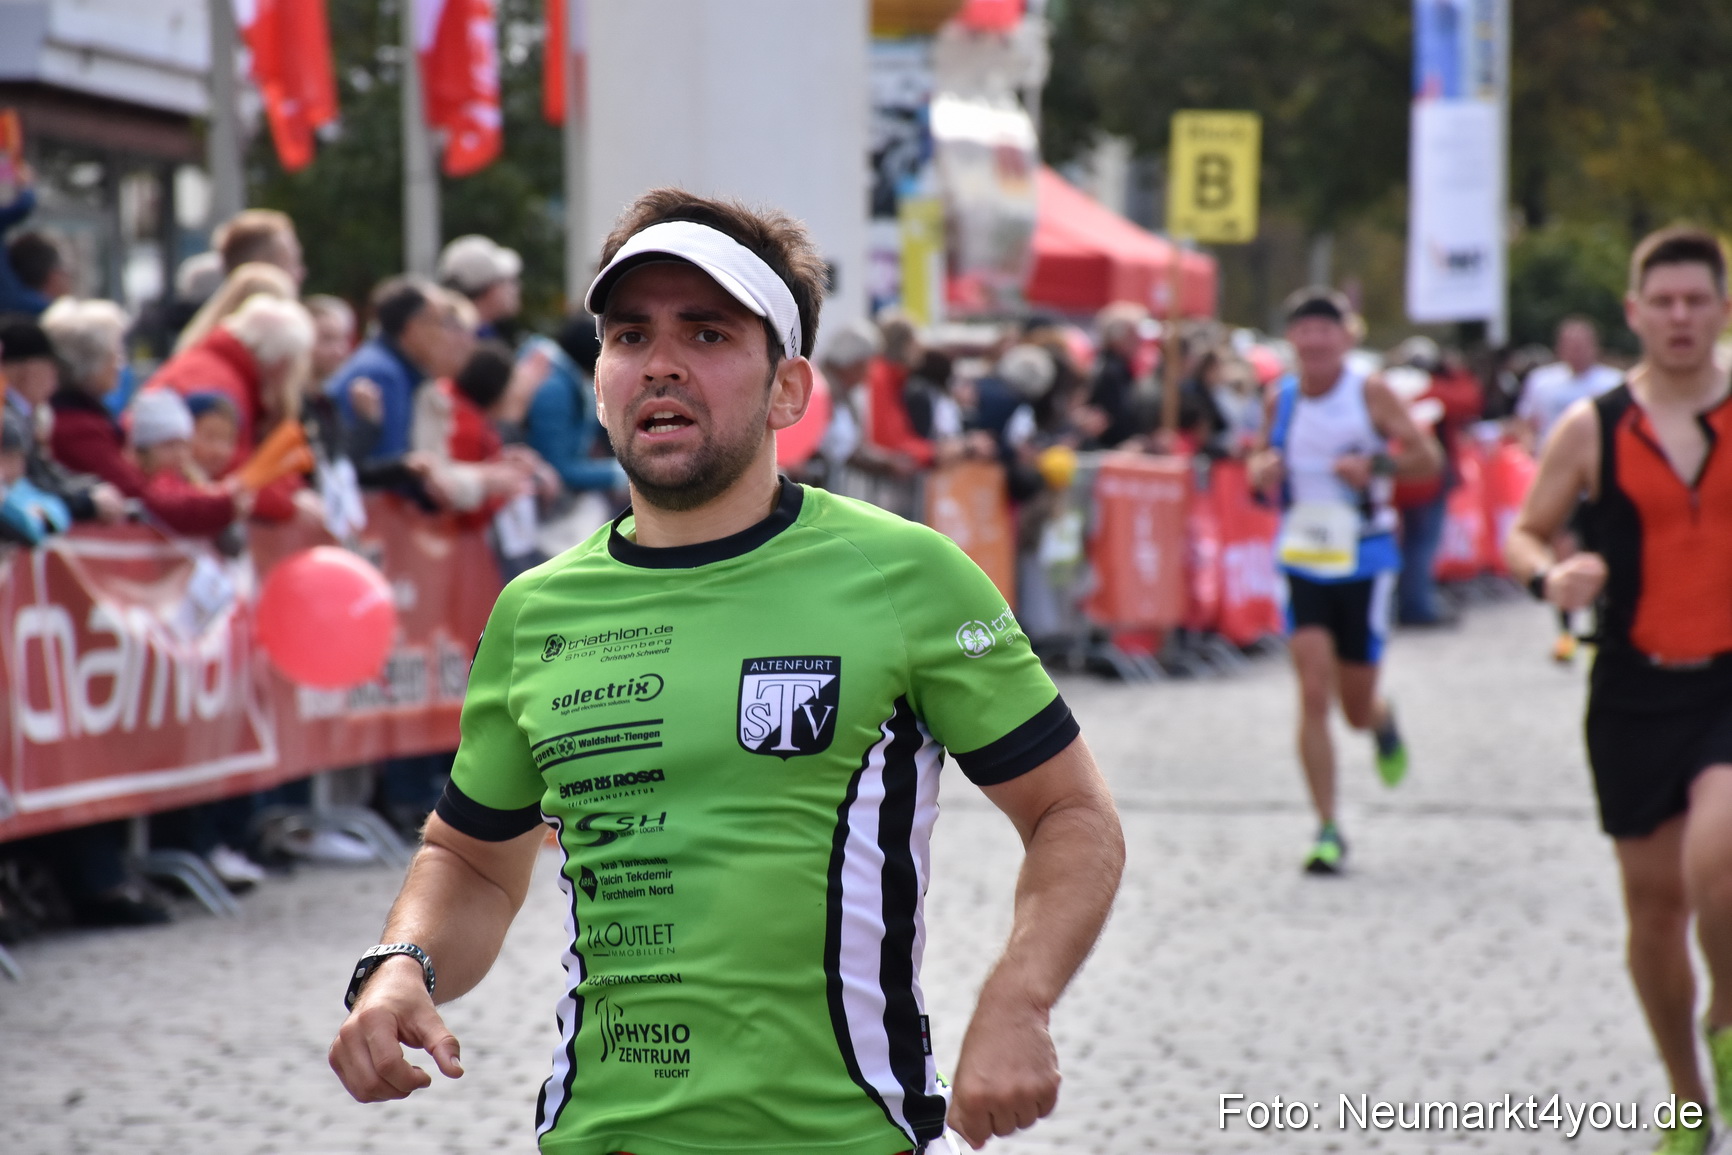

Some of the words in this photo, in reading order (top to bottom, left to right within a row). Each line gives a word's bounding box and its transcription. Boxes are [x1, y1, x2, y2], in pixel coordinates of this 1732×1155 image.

[1194, 153, 1235, 212] B
[568, 625, 673, 650] triathlon.de
[565, 650, 596, 661] Shop
[603, 639, 673, 654] Nürnberg
[600, 652, 635, 663] Christoph
[750, 659, 833, 671] ALTENFURT
[551, 678, 649, 711] solectrix
[578, 730, 660, 748] Waldshut-Tiengen
[639, 825, 665, 834] LOGISTIK
[600, 873, 623, 886] Yalcin
[626, 869, 673, 882] Tekdemir
[602, 886, 646, 901] Forchheim
[648, 884, 674, 896] Nord
[608, 947, 675, 957] IMMOBILIEN
[614, 1023, 690, 1043] PHYSIO
[618, 1047, 690, 1064] ZENTRUM
[654, 1068, 690, 1079] FEUCHT
